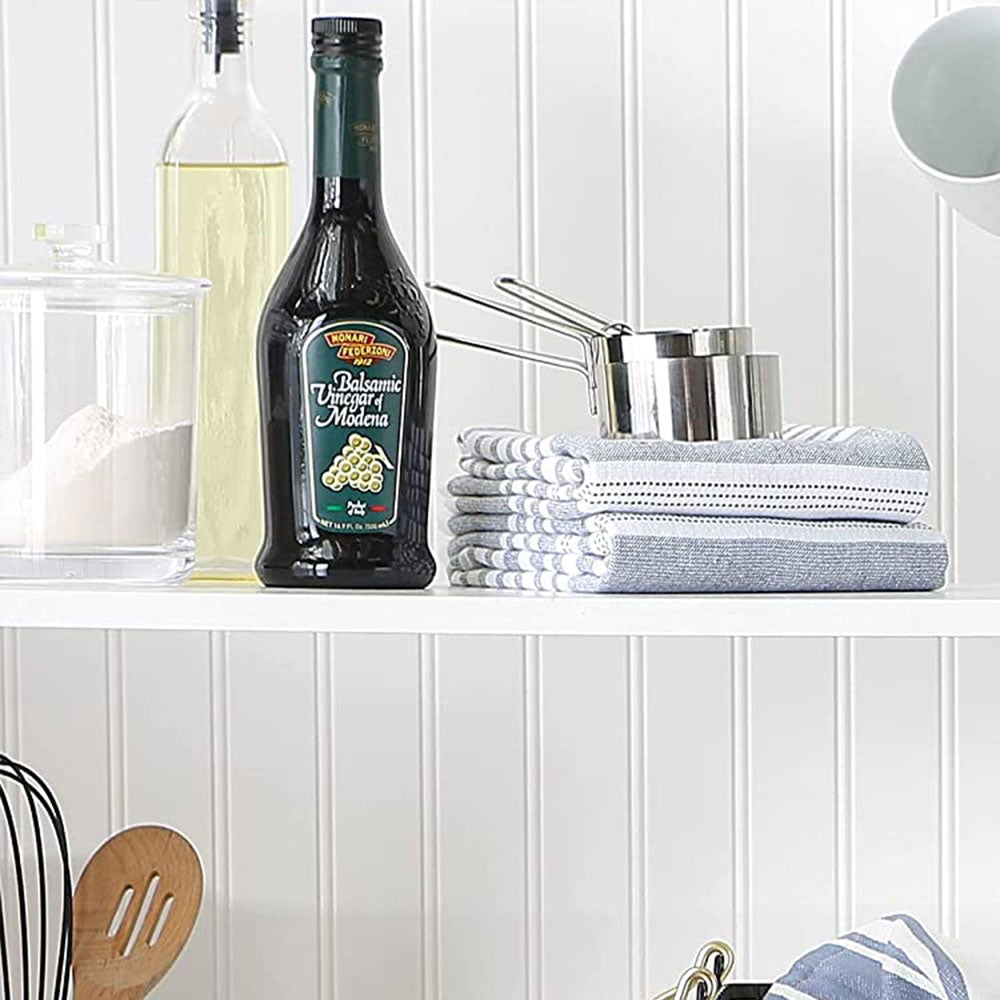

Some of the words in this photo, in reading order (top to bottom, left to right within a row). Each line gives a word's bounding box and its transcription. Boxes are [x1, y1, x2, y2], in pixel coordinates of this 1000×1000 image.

[331, 333, 368, 344] MONARI
[344, 347, 391, 357] FEDERZONI
[333, 370, 402, 393] Balsamic
[310, 383, 375, 413] Vinegar
[374, 393, 384, 412] of
[315, 404, 389, 427] Modena
